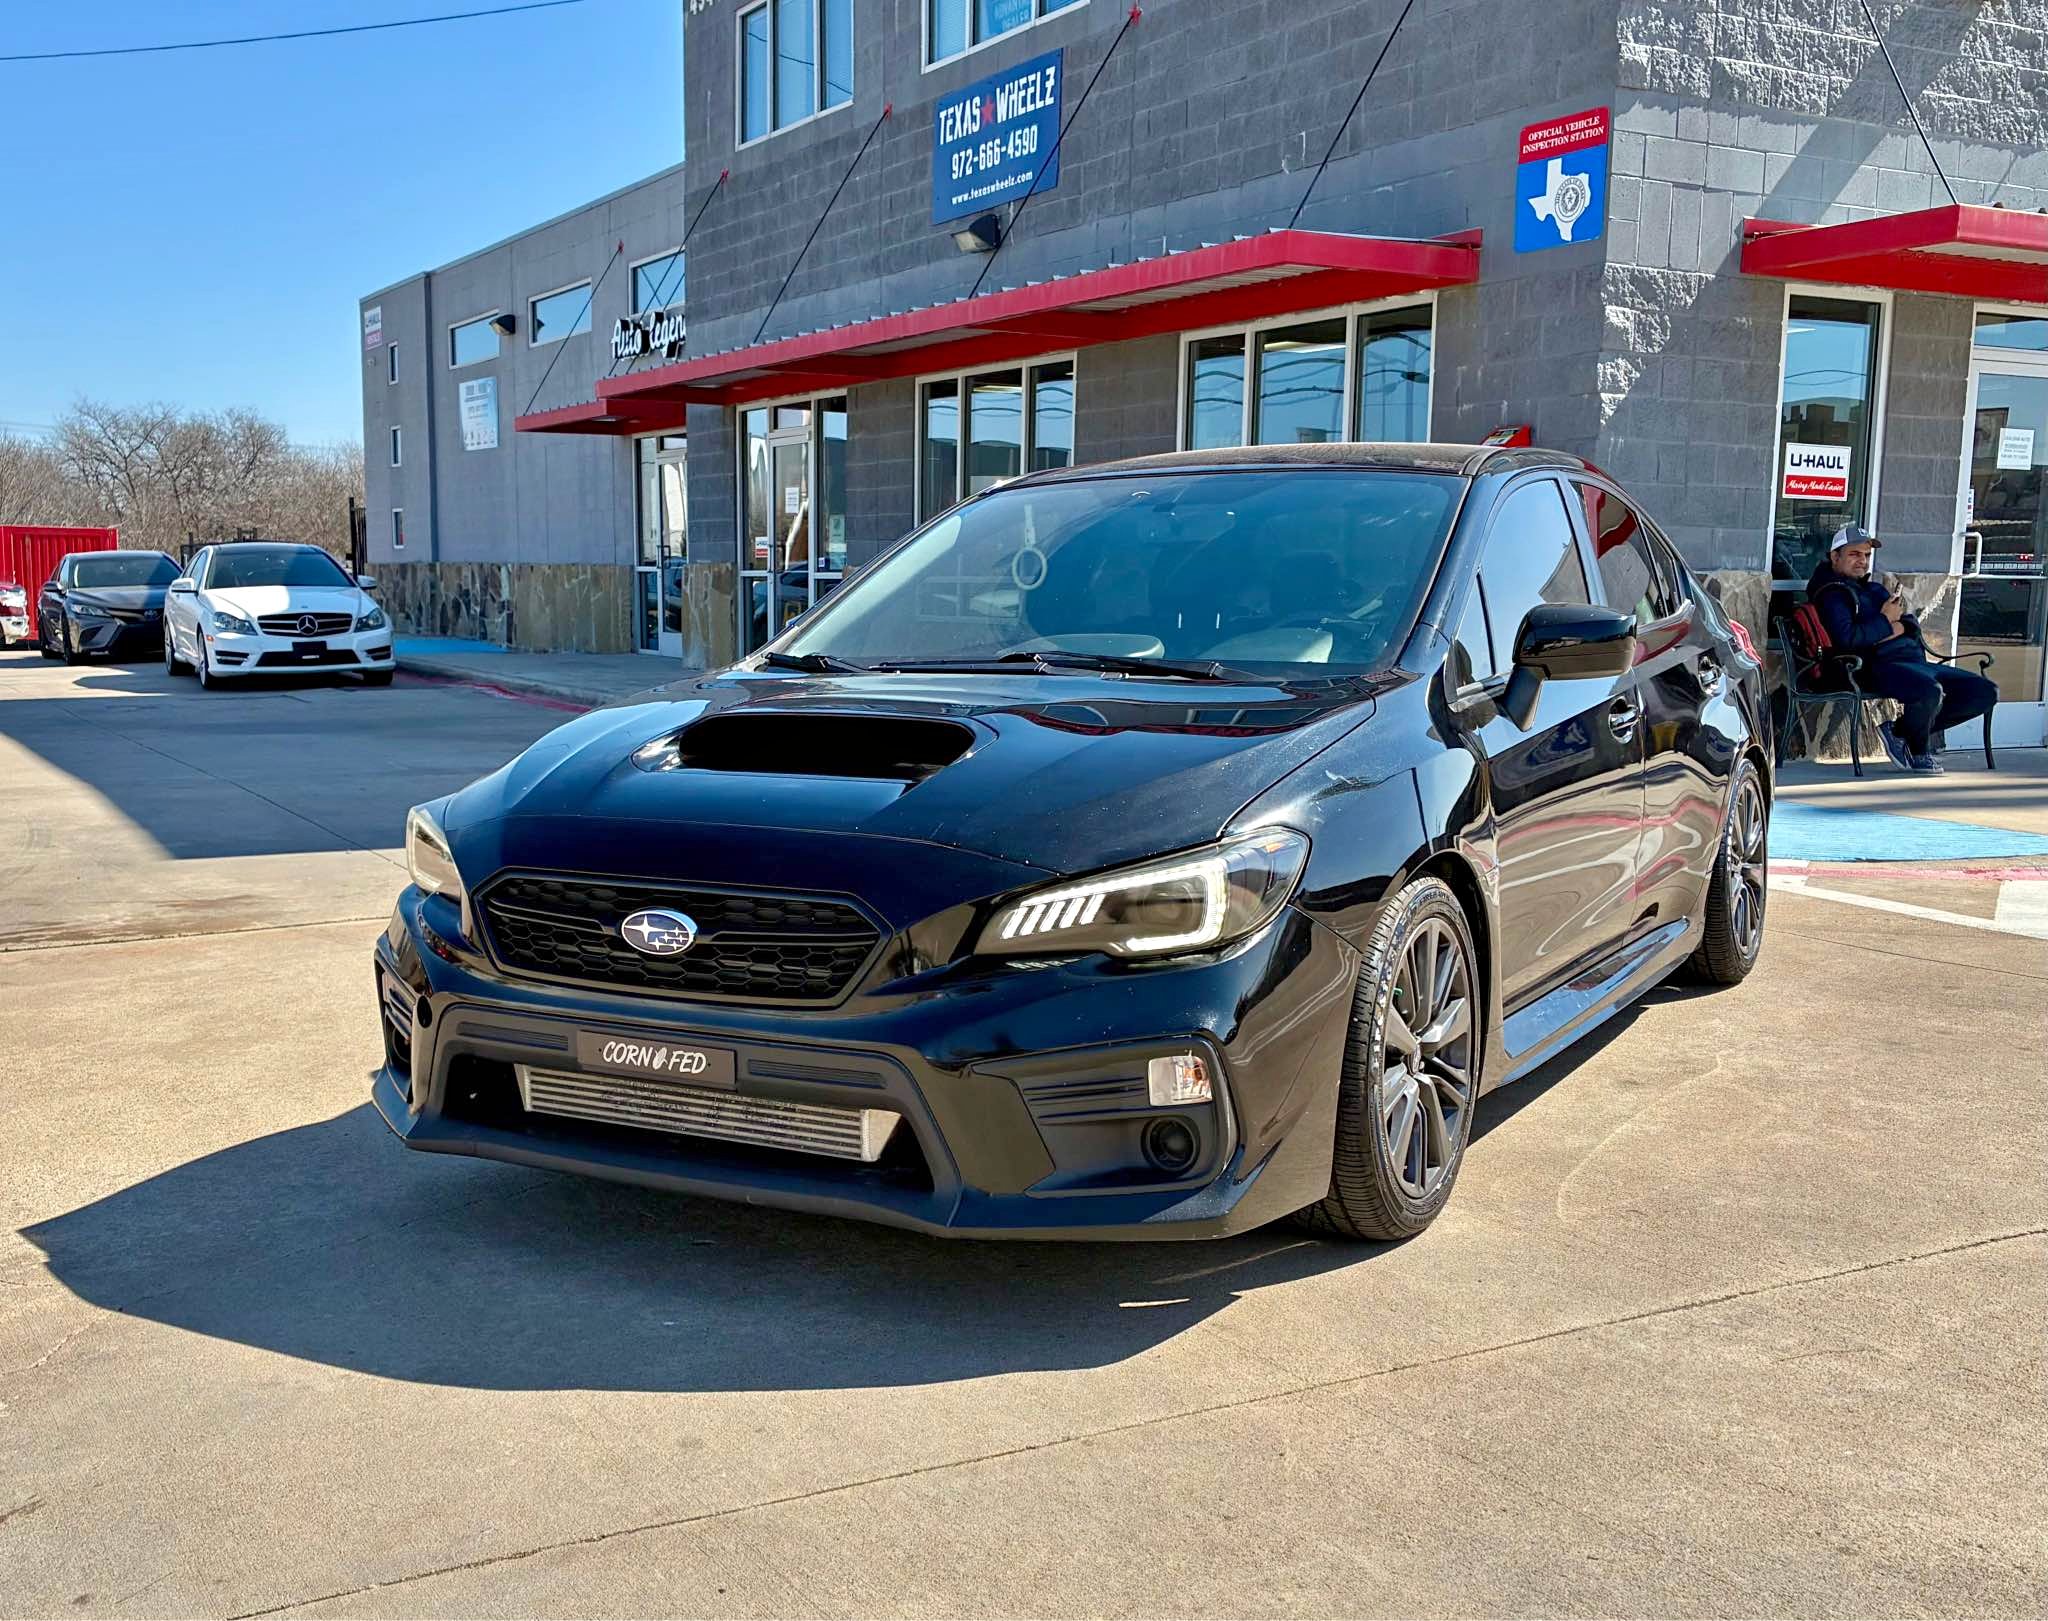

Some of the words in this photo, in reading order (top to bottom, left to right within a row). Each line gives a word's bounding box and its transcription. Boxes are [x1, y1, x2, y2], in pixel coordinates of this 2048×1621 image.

[939, 95, 981, 145] TEXAS
[996, 66, 1056, 123] WHEELZ
[1522, 134, 1569, 154] INSPECTION
[1570, 125, 1604, 143] STATION
[1528, 126, 1564, 142] OFFICIAL
[1565, 115, 1600, 134] VEHICLE
[951, 124, 1038, 180] 972-666-4590
[951, 170, 1033, 205] www.texaswheelz.com
[610, 318, 642, 359] Auto
[649, 311, 687, 359] Legen
[1790, 453, 1844, 469] U-HAUL
[1787, 480, 1808, 492] Moving
[1808, 481, 1825, 489] Made
[602, 1040, 651, 1068] CORN
[668, 1049, 707, 1074] FED
